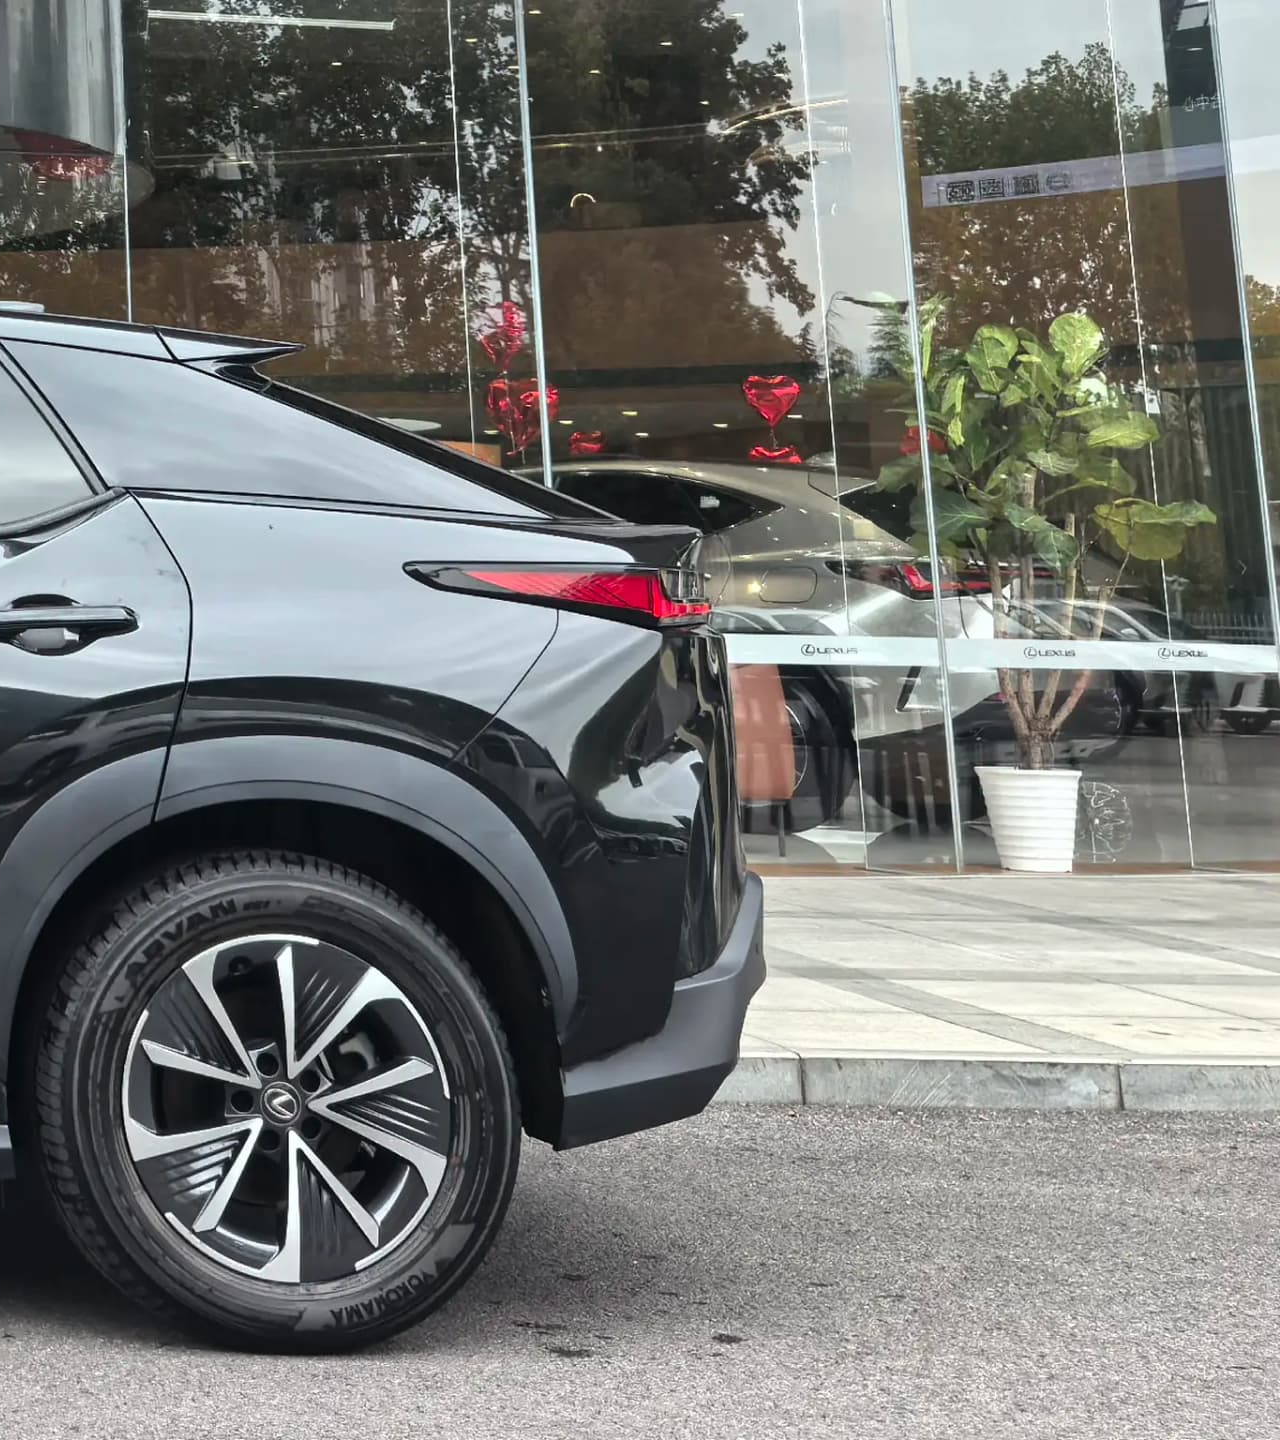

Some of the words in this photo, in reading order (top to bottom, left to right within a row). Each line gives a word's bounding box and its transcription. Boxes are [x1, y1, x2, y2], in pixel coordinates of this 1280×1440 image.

[1038, 648, 1076, 657] LEXUS
[1171, 649, 1209, 658] LEXUS
[329, 1270, 437, 1325] YOKOHAMA
